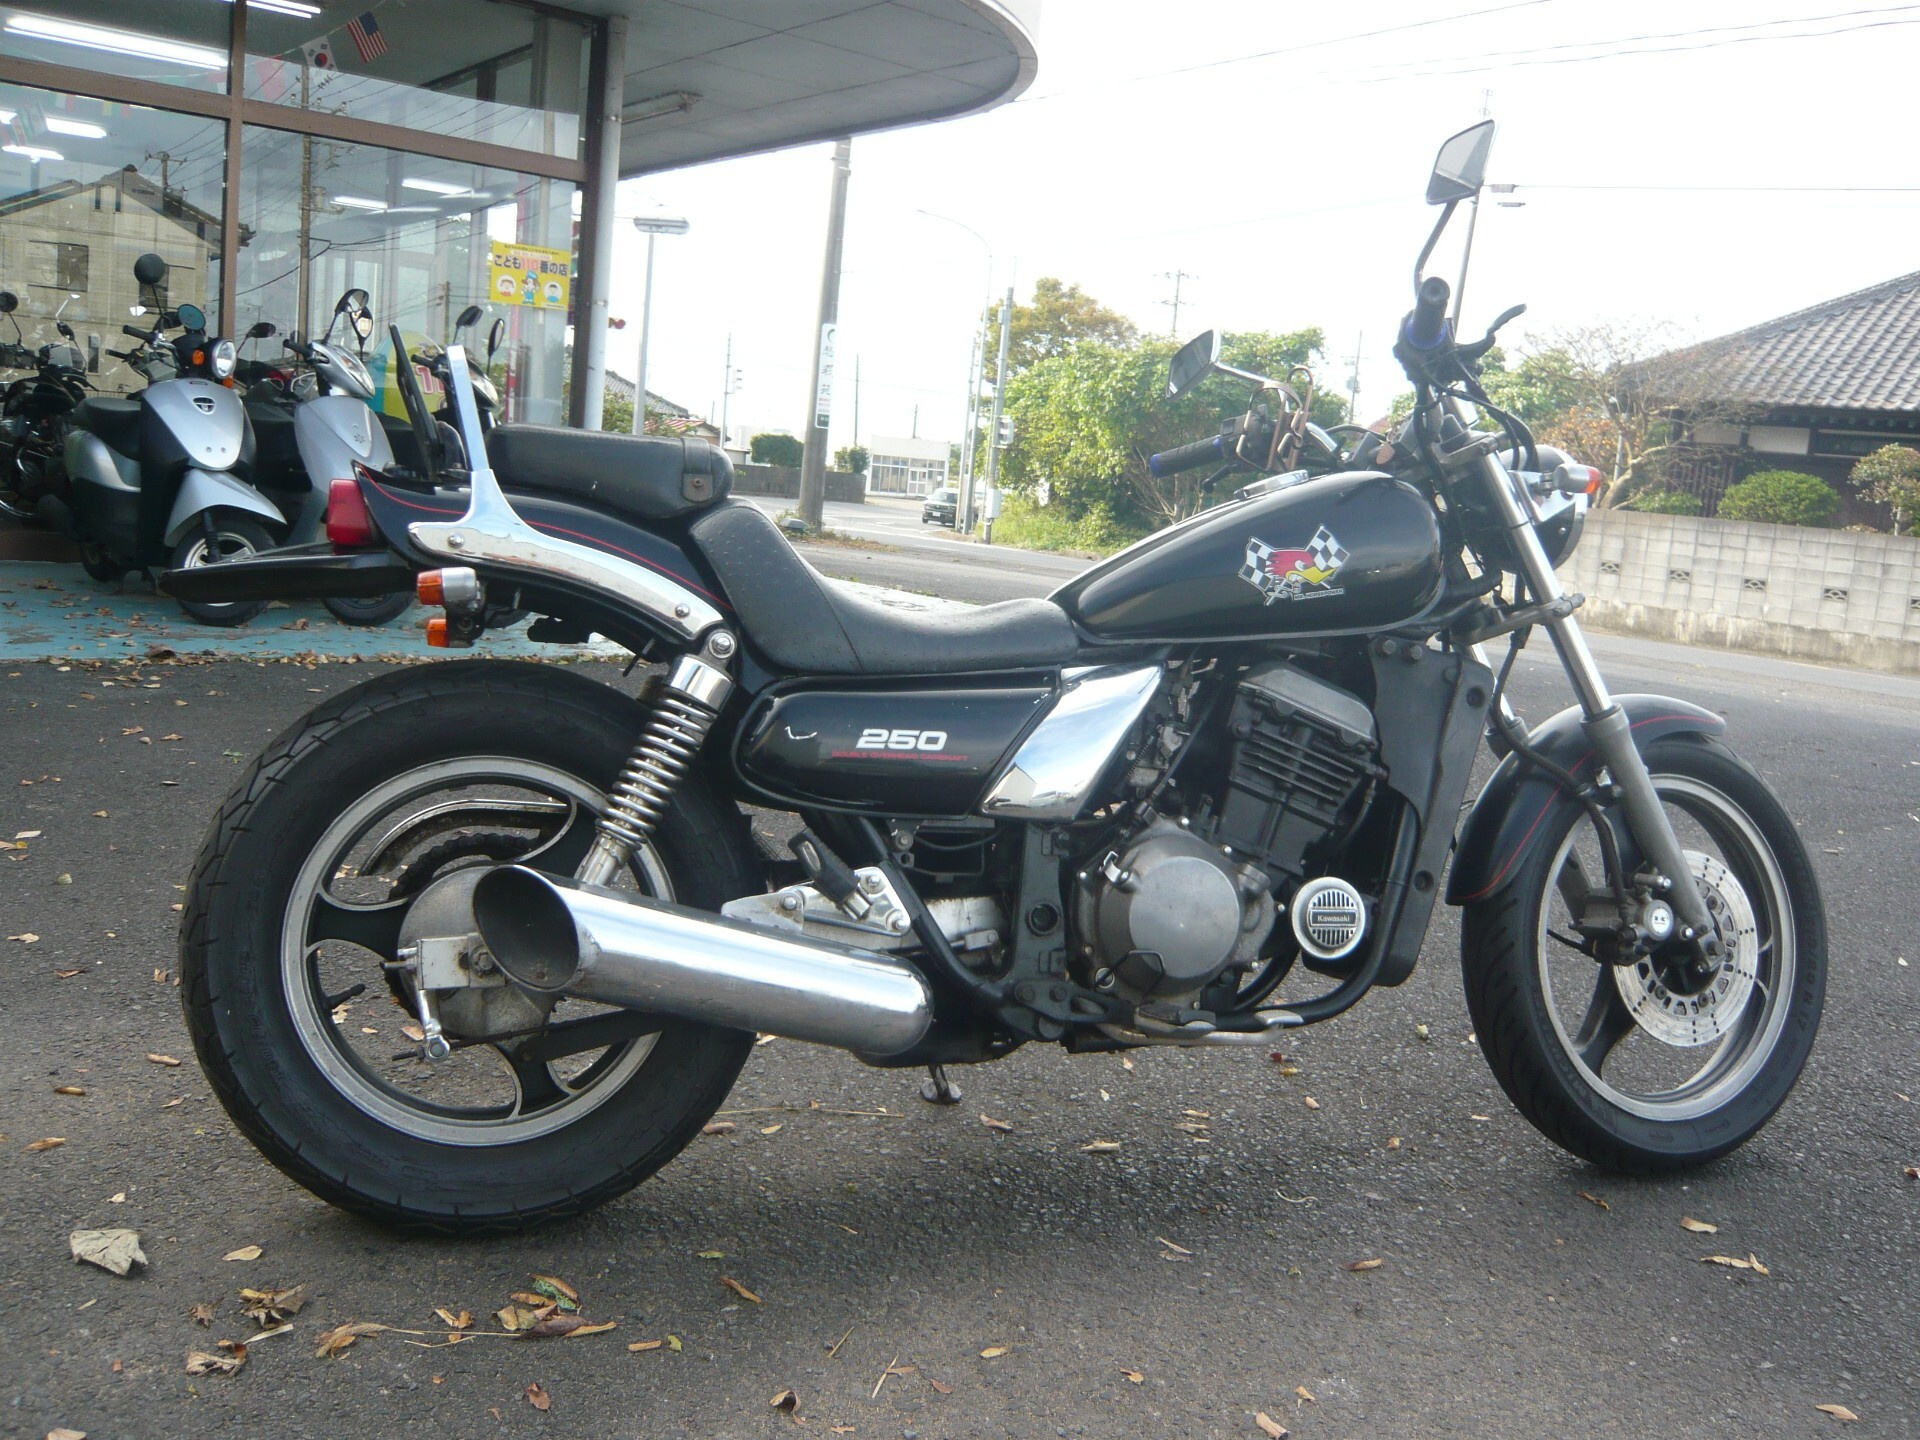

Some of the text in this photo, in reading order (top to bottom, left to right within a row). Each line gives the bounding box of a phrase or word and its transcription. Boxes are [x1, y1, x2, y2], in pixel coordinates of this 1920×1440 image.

[495, 254, 569, 276] こども110番の店
[855, 728, 948, 751] 250
[1317, 914, 1350, 922] Kawasaki
